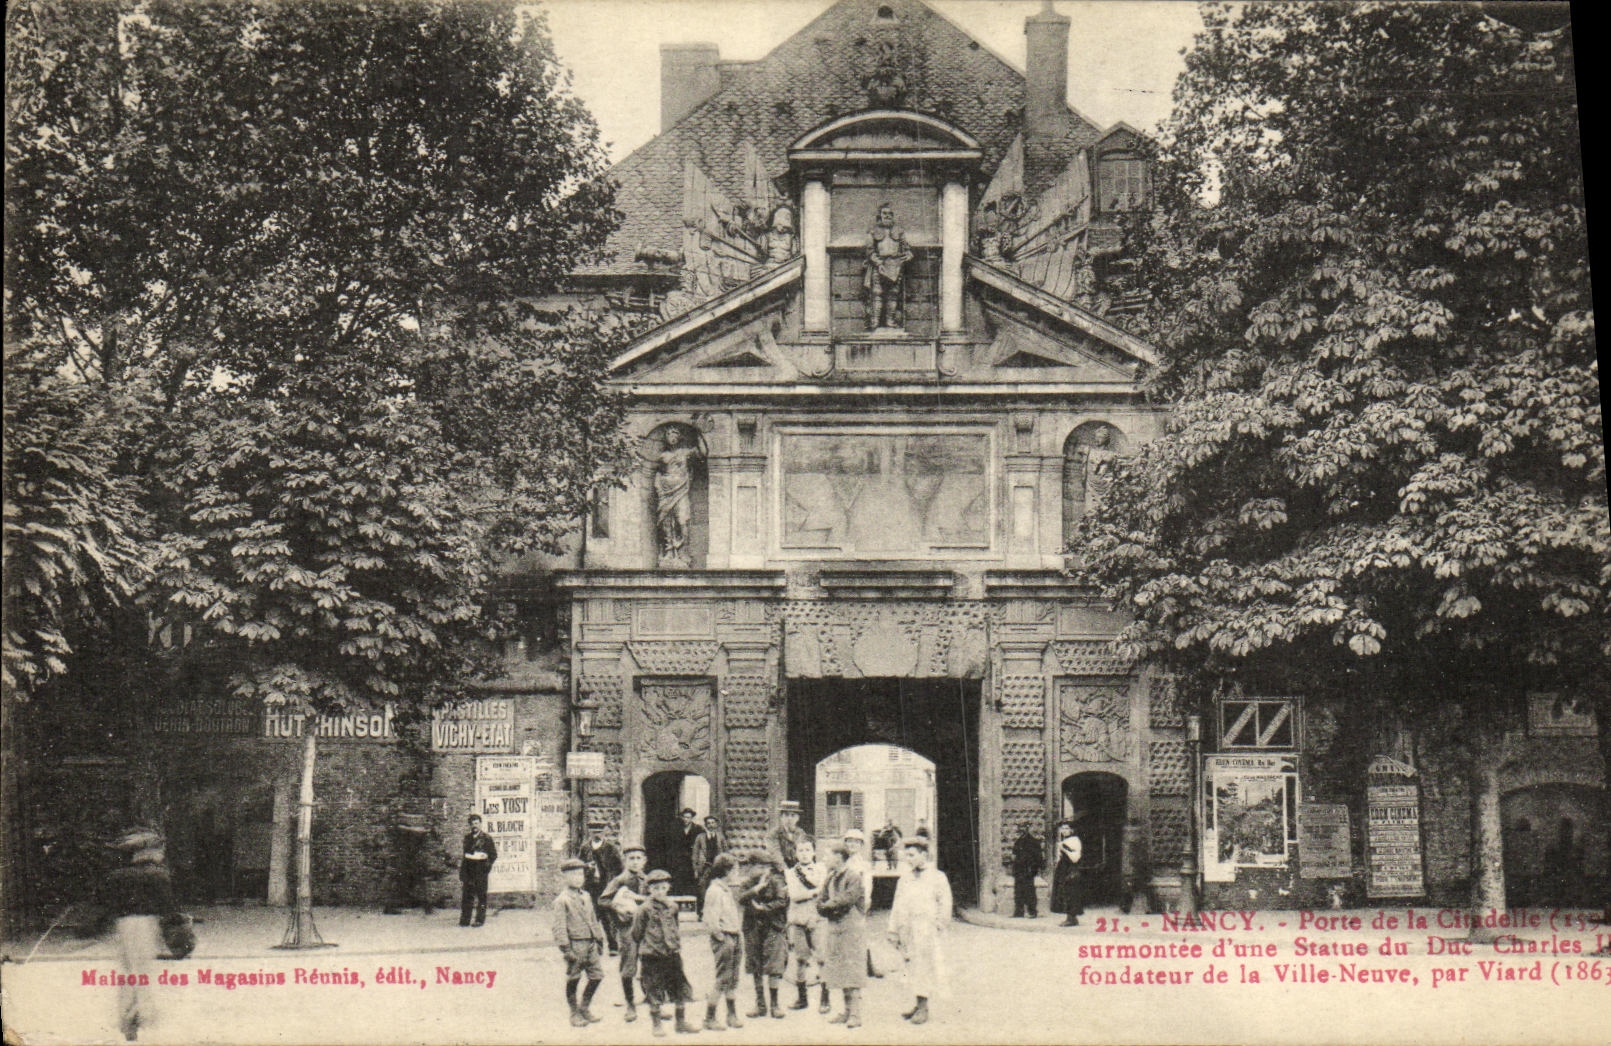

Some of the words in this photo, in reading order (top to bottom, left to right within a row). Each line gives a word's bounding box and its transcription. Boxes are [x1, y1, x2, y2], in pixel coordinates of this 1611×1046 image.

[441, 701, 507, 719] PASTILLES
[502, 797, 528, 814] YOST
[497, 820, 525, 833] BLOCH
